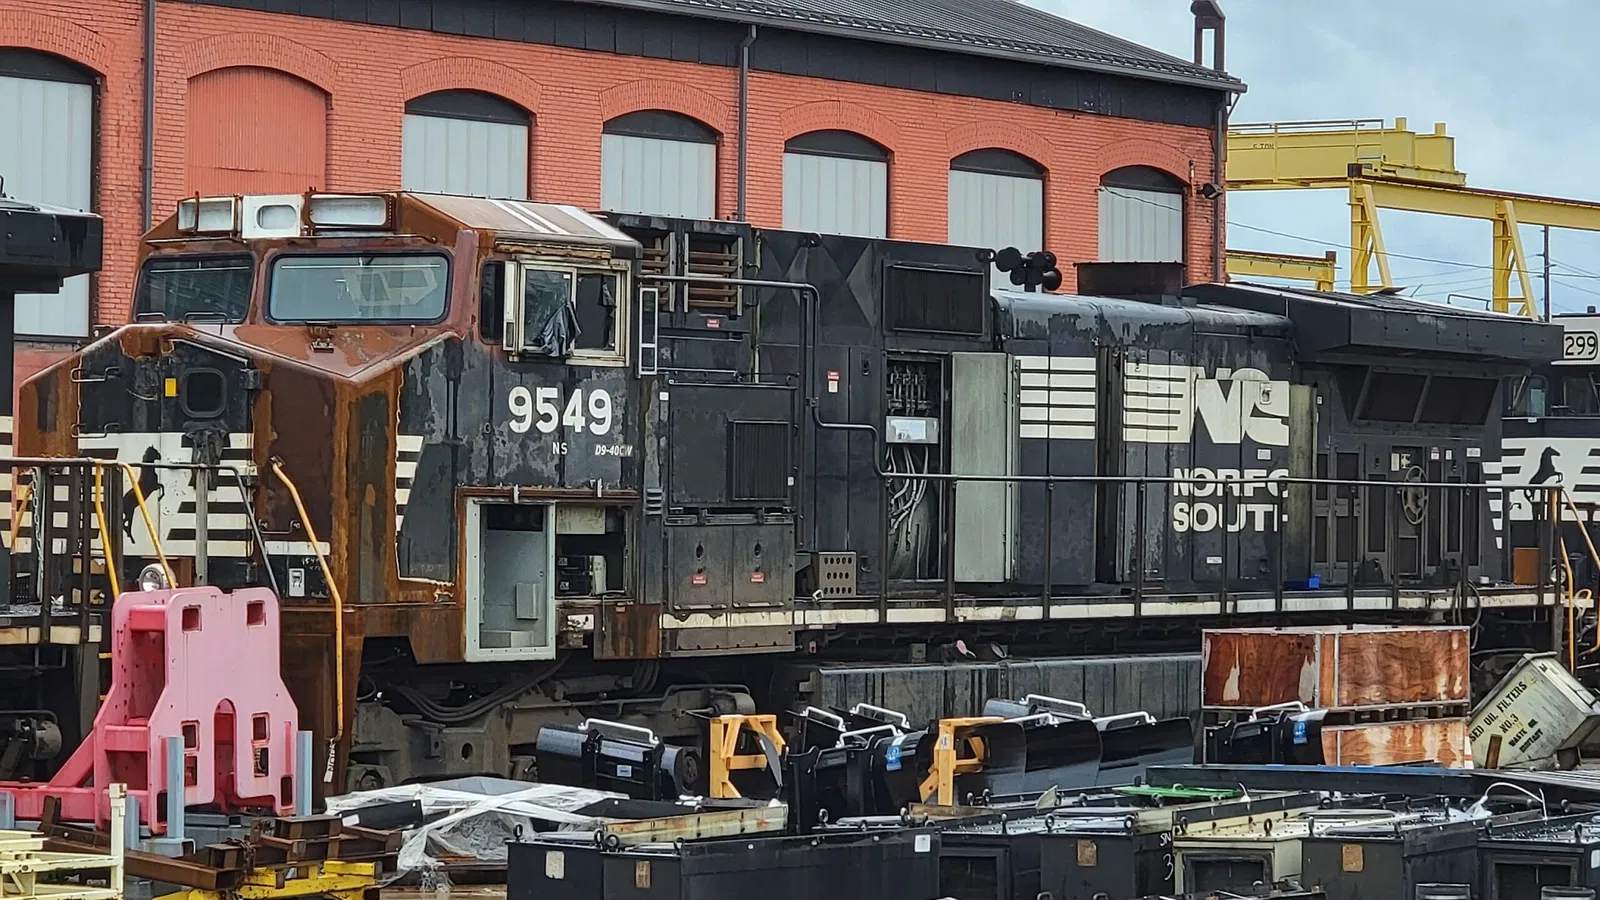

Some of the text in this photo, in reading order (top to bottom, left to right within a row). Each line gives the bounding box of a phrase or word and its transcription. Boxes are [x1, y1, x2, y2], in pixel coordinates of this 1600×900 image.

[508, 386, 612, 436] 9549
[552, 442, 568, 455] NS
[595, 444, 633, 457] D9-40CW
[1469, 681, 1528, 742] SED OIL FILTERS
[1499, 713, 1519, 734] NO.3
[1508, 728, 1527, 747] WASTE
